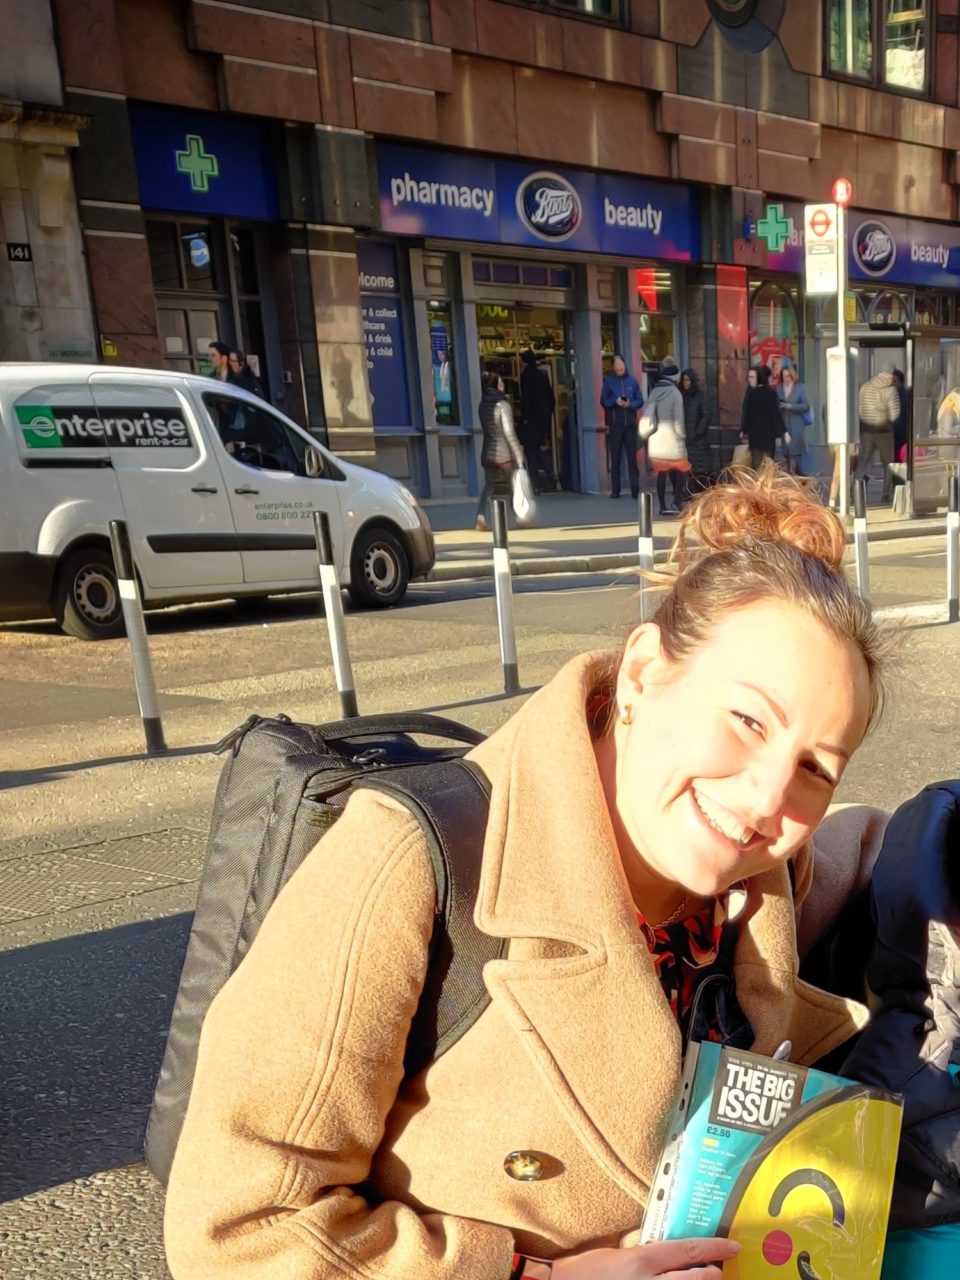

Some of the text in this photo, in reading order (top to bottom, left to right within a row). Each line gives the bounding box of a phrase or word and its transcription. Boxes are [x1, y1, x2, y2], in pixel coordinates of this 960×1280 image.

[391, 172, 662, 235] pharmacy Boots beauty
[10, 247, 29, 259] 141
[911, 240, 950, 268] beauty
[21, 412, 187, 443] enterprise
[135, 436, 189, 446] rent-a-car
[726, 1063, 765, 1094] THE
[762, 1073, 796, 1102] BIG
[706, 1126, 731, 1138] £2.50
